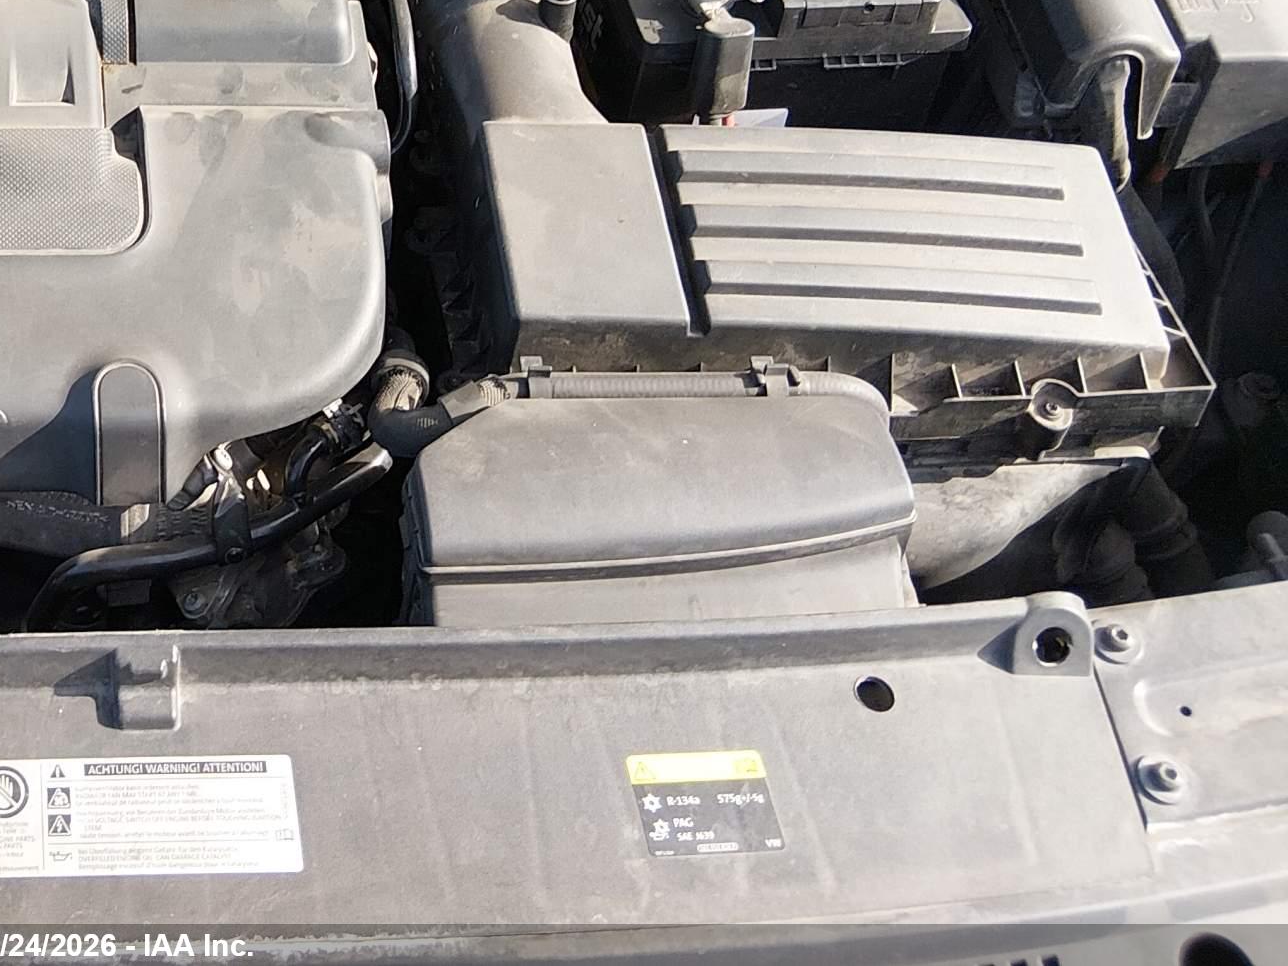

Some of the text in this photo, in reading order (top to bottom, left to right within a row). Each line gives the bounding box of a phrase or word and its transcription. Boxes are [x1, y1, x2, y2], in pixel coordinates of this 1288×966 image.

[87, 761, 263, 775] ACHTUNG! WARNING! ATTENTION!
[673, 817, 694, 828] PAG
